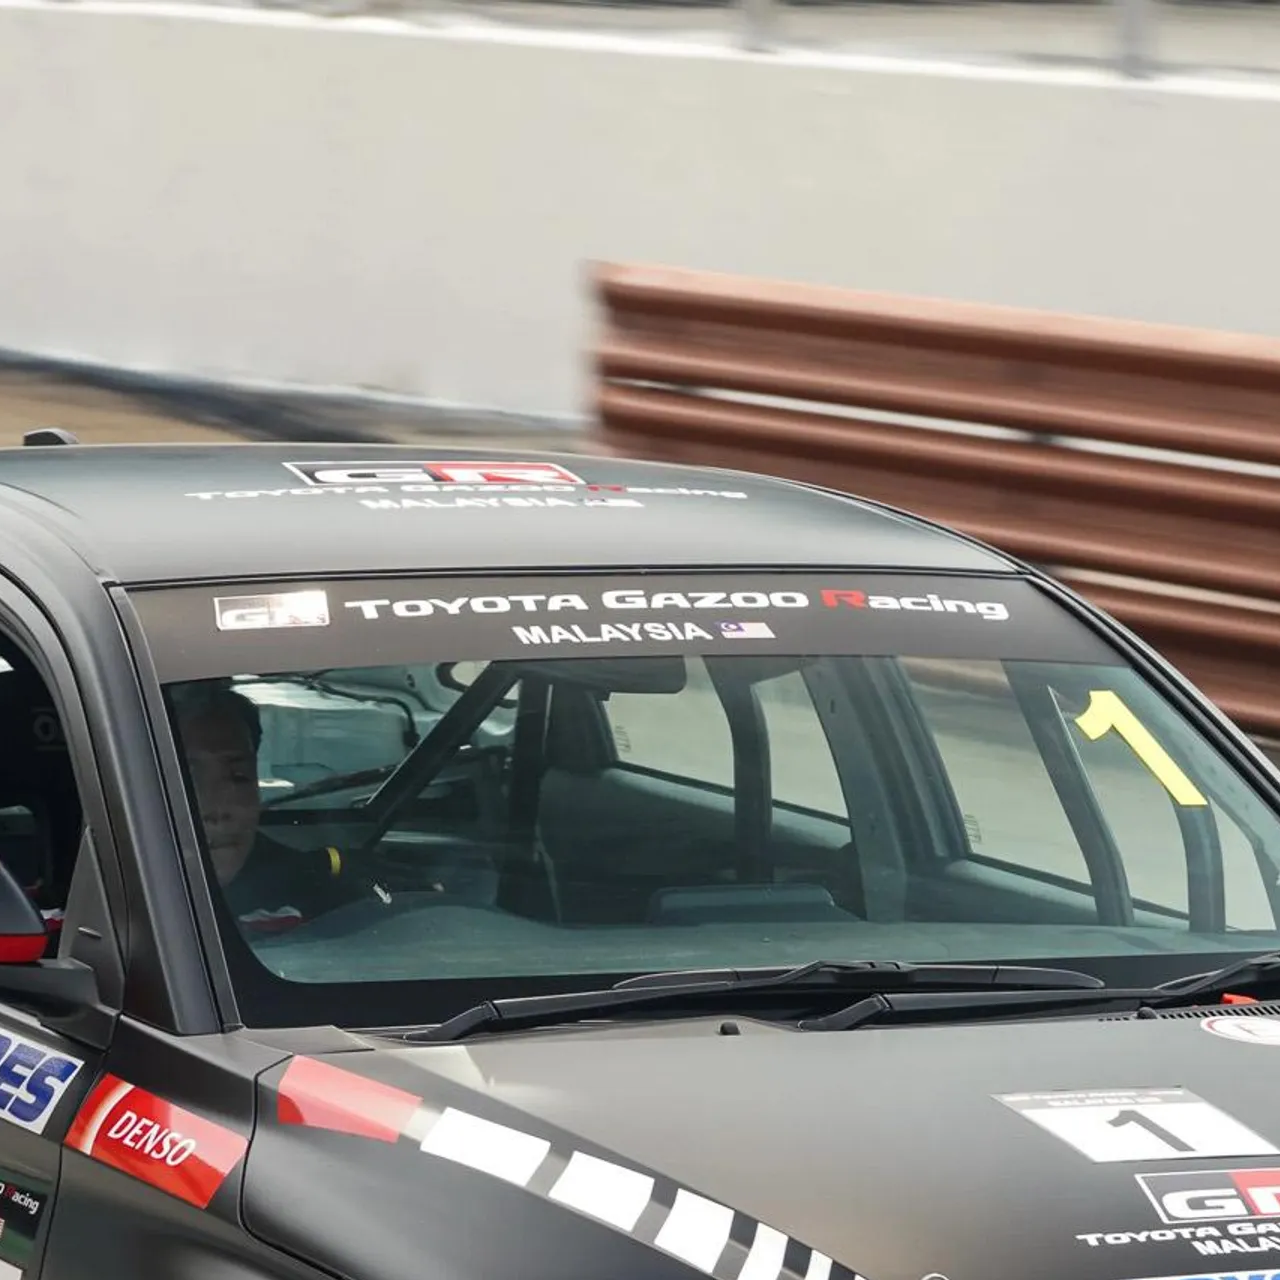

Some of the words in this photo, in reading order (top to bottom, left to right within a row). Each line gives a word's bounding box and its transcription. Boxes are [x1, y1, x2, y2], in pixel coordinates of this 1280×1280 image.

[344, 594, 588, 620] TOYOTA
[601, 589, 809, 609] GAZOO
[821, 589, 1010, 621] Racing
[510, 622, 714, 645] MALAYSIA
[1074, 690, 1208, 805] 1
[108, 1110, 197, 1167] DENSO
[1106, 1109, 1197, 1152] 1
[4, 1183, 40, 1215] Racing
[1076, 1225, 1222, 1247] TOYOTA
